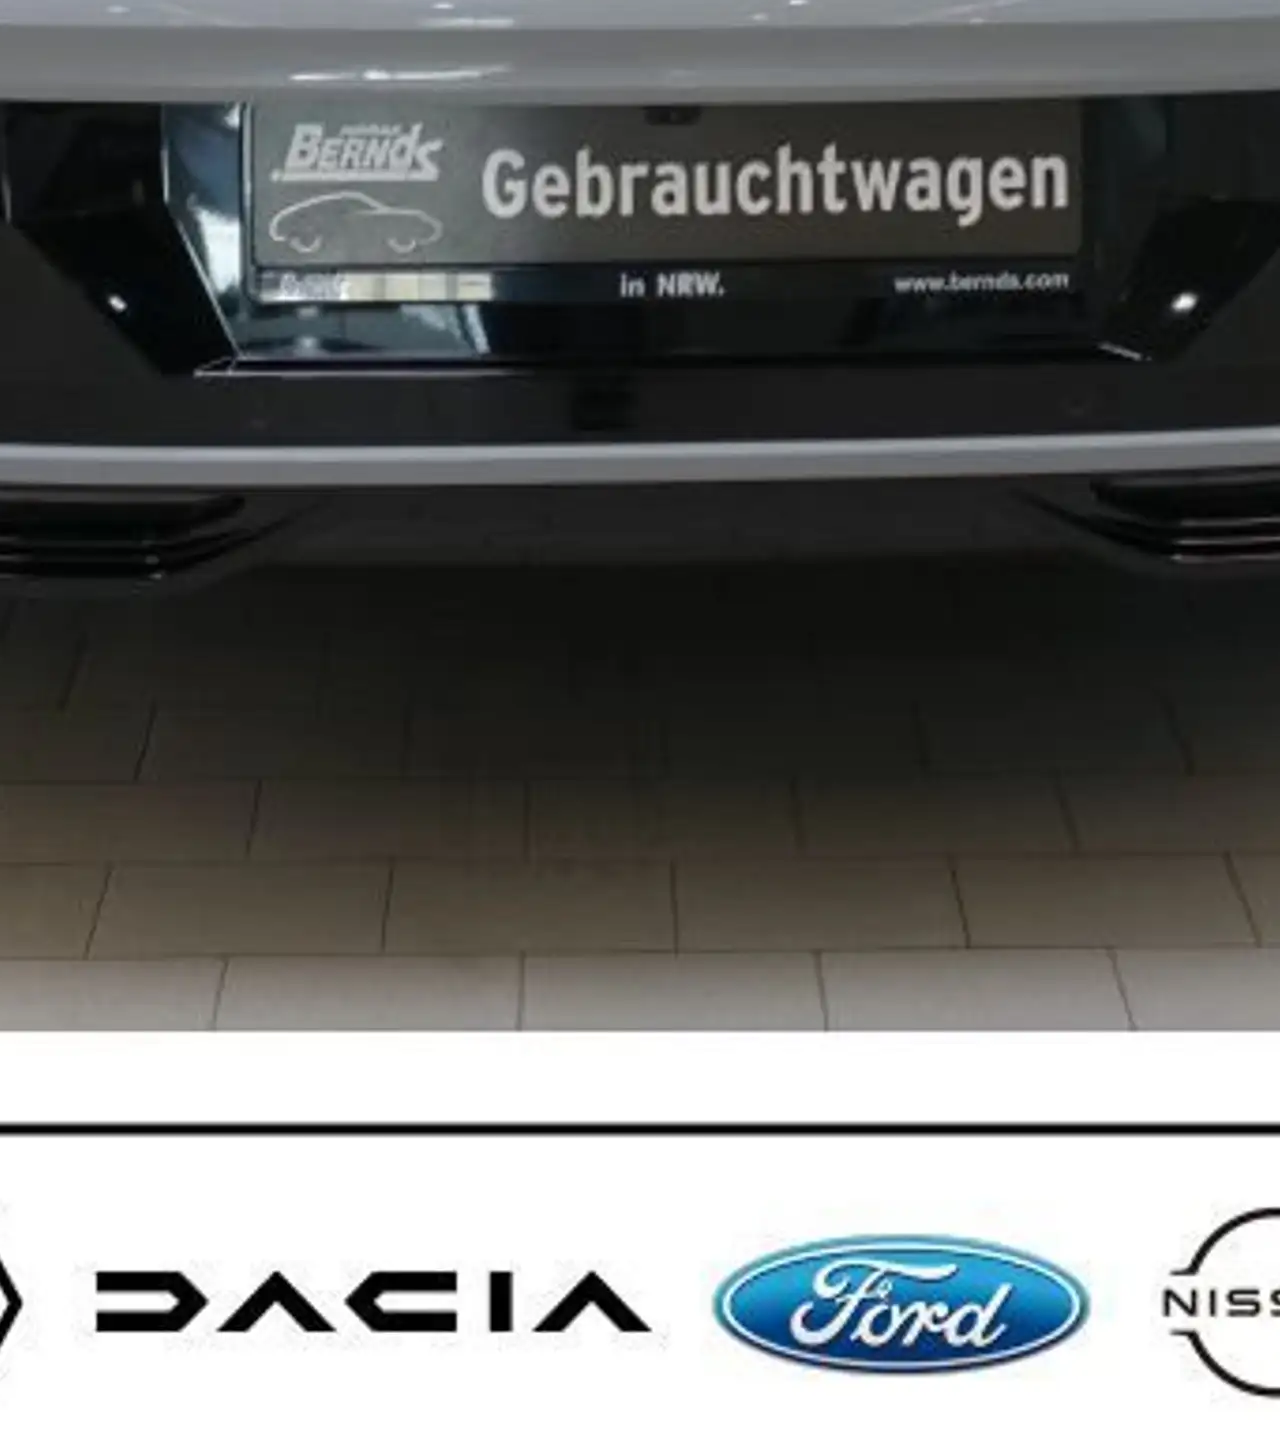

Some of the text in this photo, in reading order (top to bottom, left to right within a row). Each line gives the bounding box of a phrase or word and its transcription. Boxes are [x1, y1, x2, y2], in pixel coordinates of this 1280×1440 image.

[481, 143, 1070, 228] Gebrauchtwagen
[620, 270, 726, 299] in NRW.
[893, 269, 1071, 294] www.bernds.com
